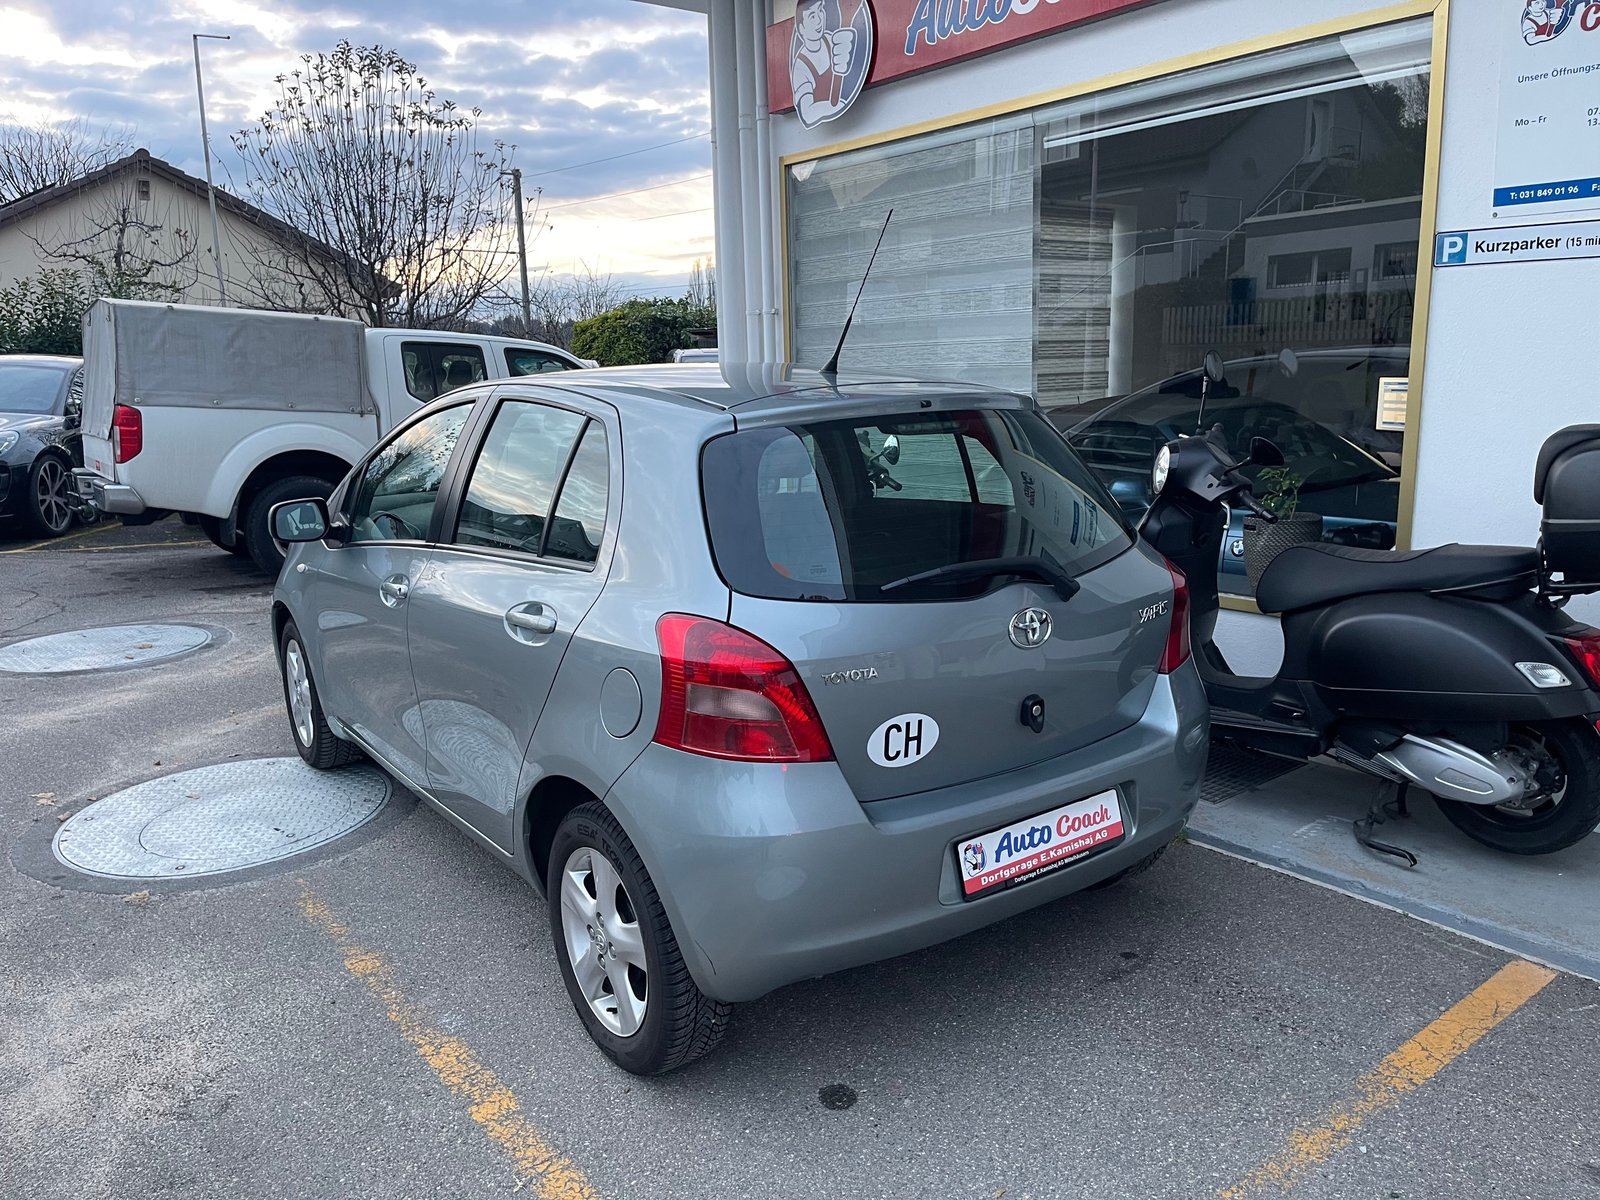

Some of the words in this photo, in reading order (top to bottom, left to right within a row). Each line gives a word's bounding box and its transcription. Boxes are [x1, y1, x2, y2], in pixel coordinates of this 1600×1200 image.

[1517, 72, 1549, 84] Unsere
[1514, 118, 1529, 127] Mo
[1538, 115, 1547, 124] Fr
[1510, 192, 1518, 200] T:
[1519, 190, 1534, 199] 031
[1537, 188, 1553, 198] 849
[1554, 187, 1565, 195] 01
[1568, 185, 1579, 194] 96
[1591, 183, 1600, 191] F:
[1442, 236, 1464, 262] P
[1475, 236, 1562, 254] Kurzparker
[1565, 236, 1582, 250] (15
[821, 667, 879, 686] TOYOTA
[883, 719, 923, 761] CH
[995, 825, 1052, 863] Auto
[1056, 804, 1111, 837] Coach
[981, 857, 1039, 885] Dorfgarage
[1040, 835, 1093, 862] E.Kamishaj
[1095, 830, 1108, 841] AG
